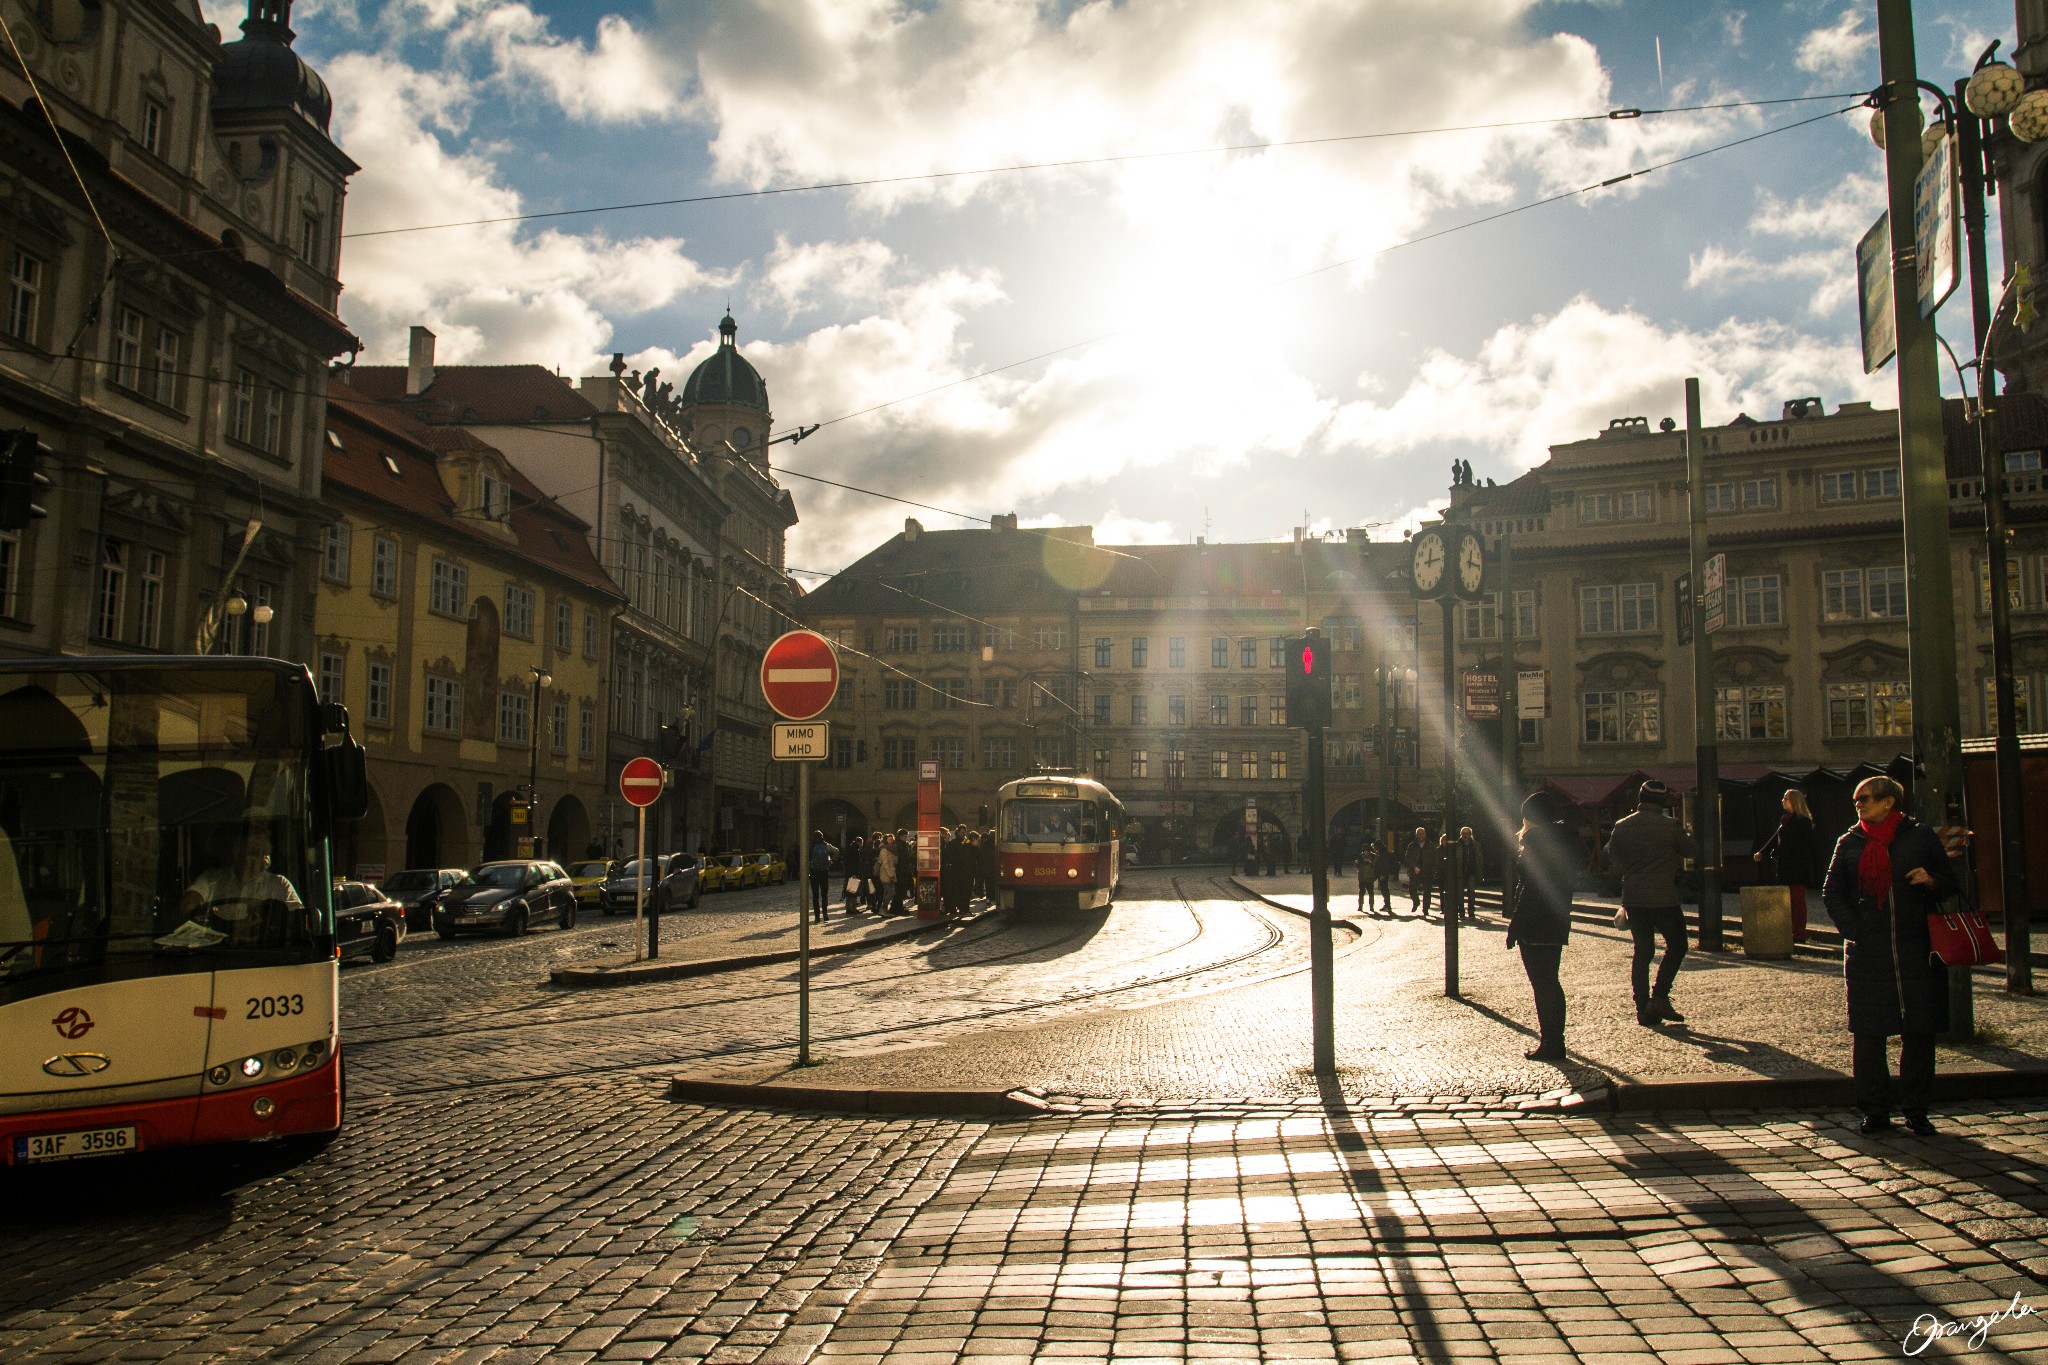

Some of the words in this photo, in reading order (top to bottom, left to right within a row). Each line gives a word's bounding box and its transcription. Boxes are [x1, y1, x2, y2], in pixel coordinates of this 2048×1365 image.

[1916, 199, 1930, 235] pro
[1706, 588, 1722, 611] VEGAN
[1466, 674, 1498, 682] HOSTEL
[786, 728, 814, 739] MIMO
[788, 744, 812, 755] MHD
[1034, 867, 1057, 876] 8394
[246, 994, 304, 1020] 2033
[32, 1136, 67, 1156] 3AF
[81, 1130, 127, 1151] 3596
